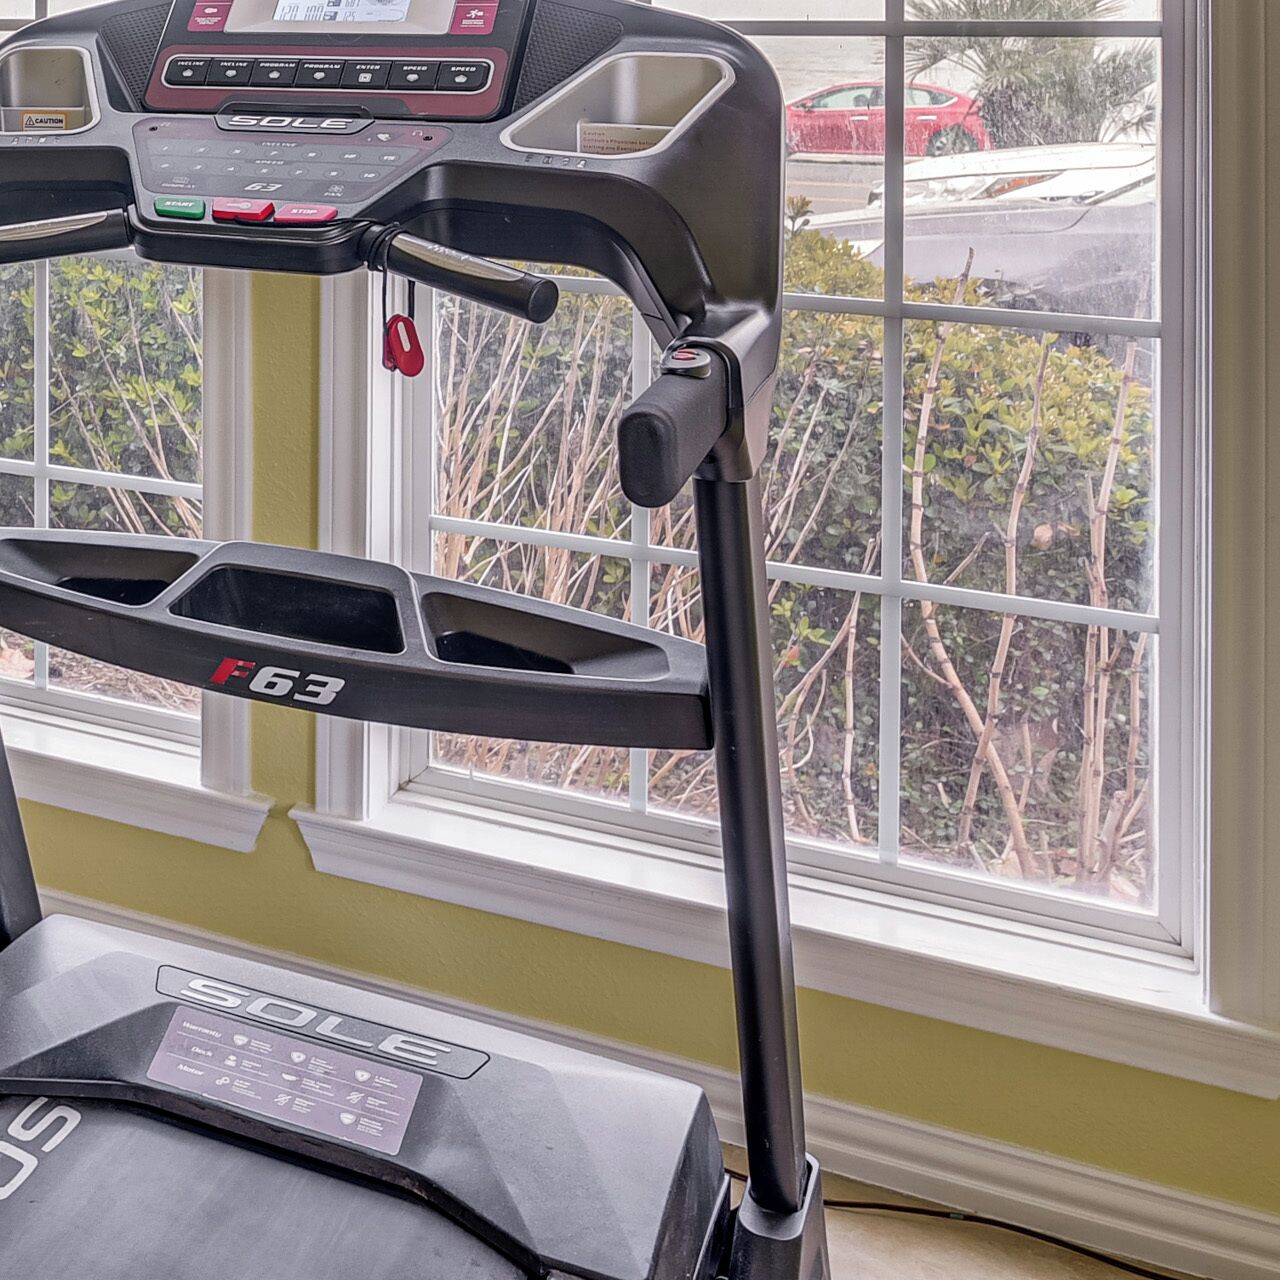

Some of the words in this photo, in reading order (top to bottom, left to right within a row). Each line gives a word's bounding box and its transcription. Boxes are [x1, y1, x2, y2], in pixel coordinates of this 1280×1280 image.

[35, 116, 64, 125] CAUTION
[229, 115, 353, 129] SOLE
[163, 200, 196, 208] START
[210, 657, 345, 706] F63
[180, 978, 452, 1066] SOLE
[182, 1021, 222, 1038] Warranty
[191, 1045, 213, 1057] Deck
[177, 1063, 205, 1076] Motor
